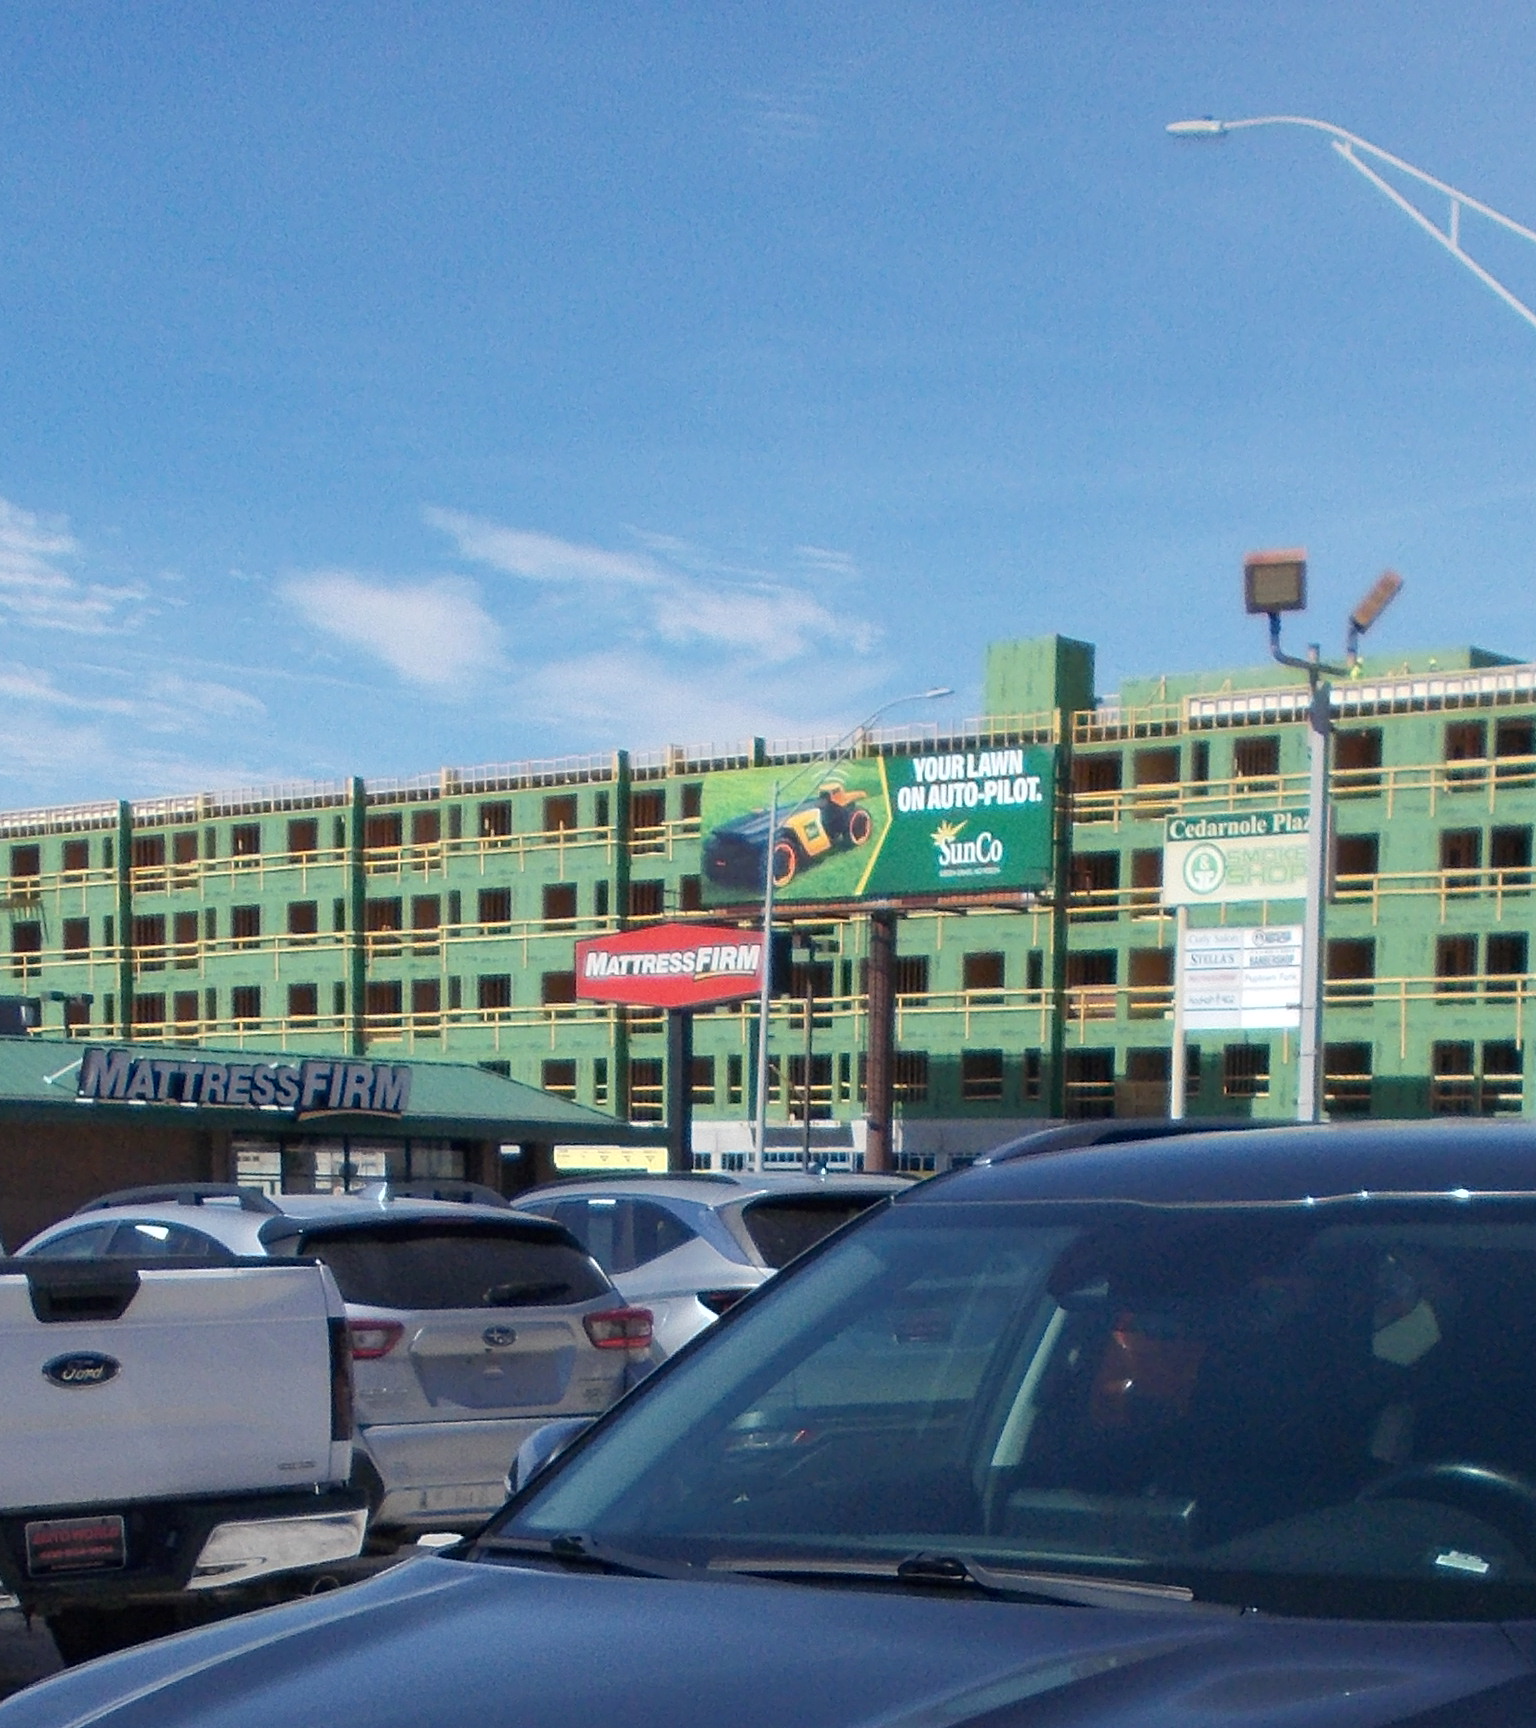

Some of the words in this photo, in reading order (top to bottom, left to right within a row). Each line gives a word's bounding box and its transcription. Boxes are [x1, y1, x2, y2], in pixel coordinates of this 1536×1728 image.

[913, 753, 964, 782] YOUR
[967, 750, 1023, 778] LAWN
[898, 786, 925, 812] ON
[927, 776, 1043, 810] AUTO-PILOT.
[1169, 815, 1267, 839] Cedarnole
[939, 832, 1003, 865] SunCo
[1226, 862, 1308, 885] SHOP
